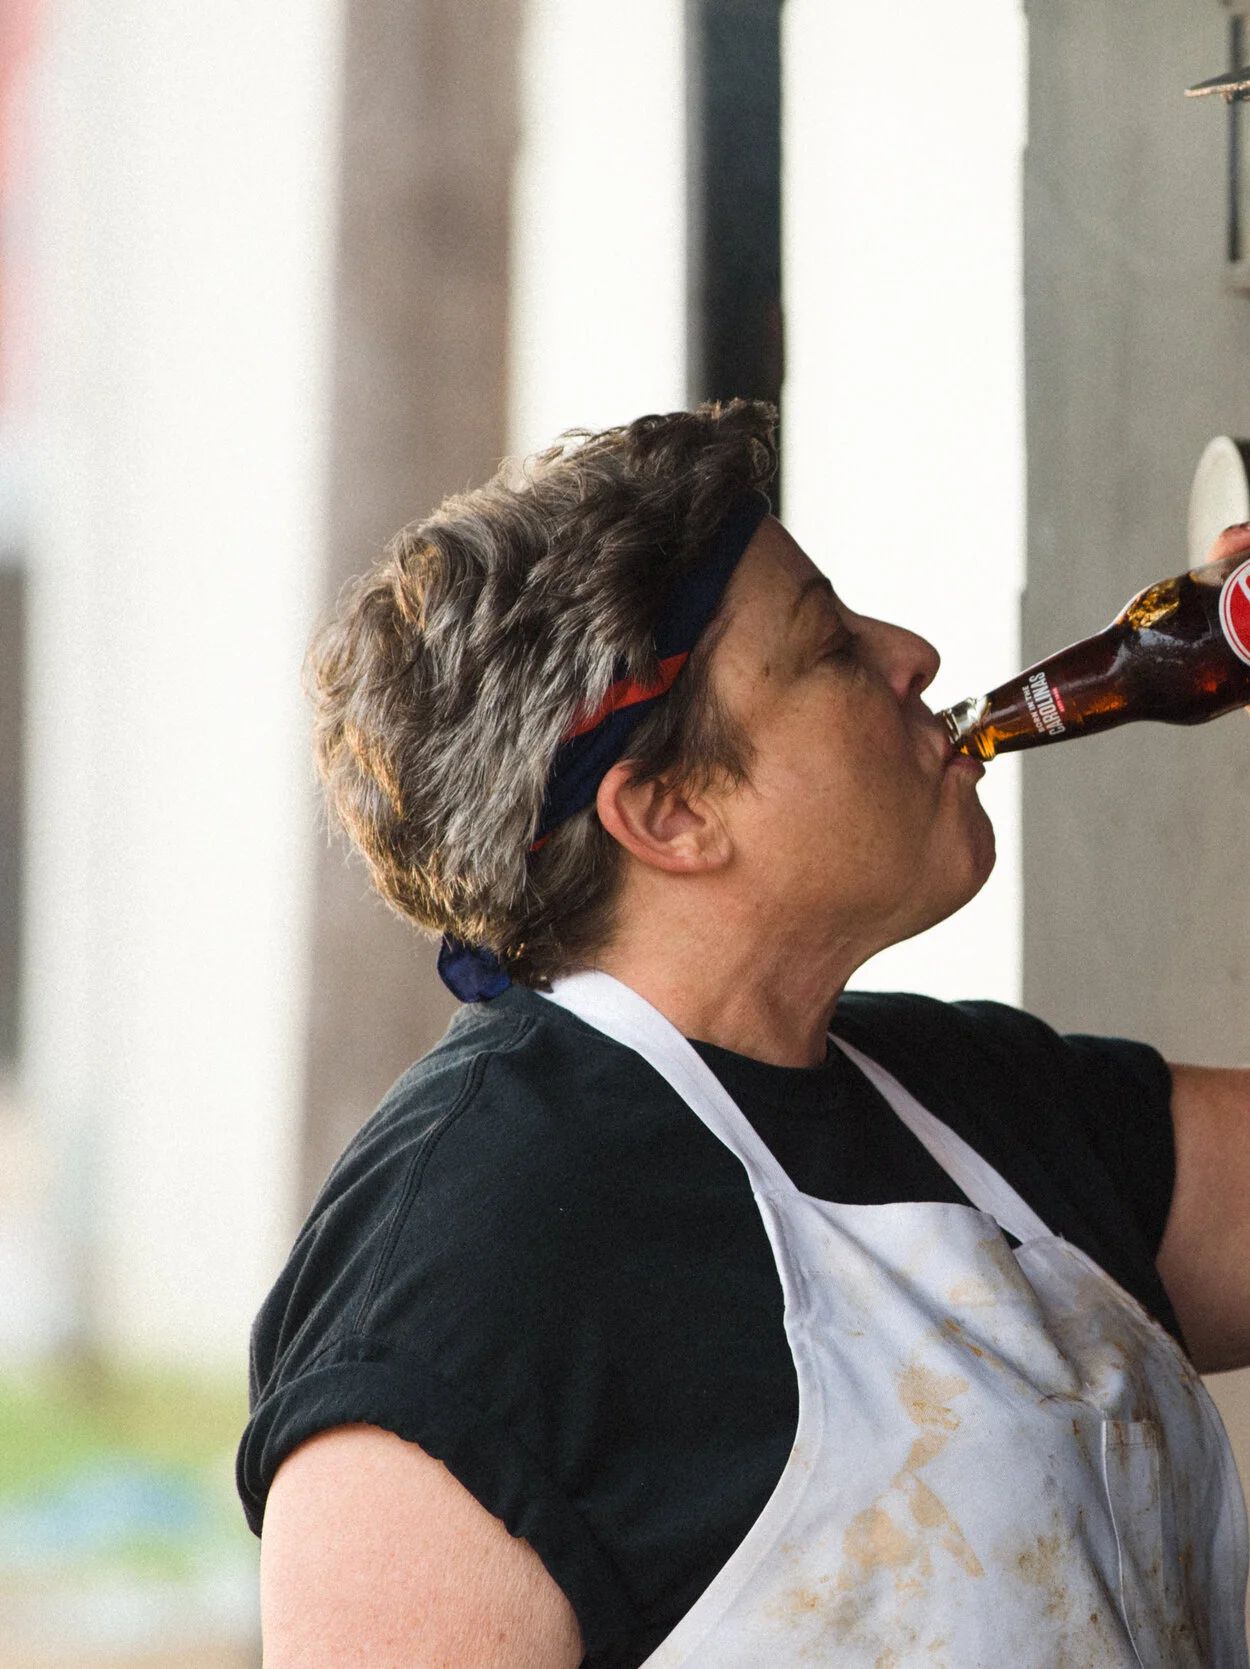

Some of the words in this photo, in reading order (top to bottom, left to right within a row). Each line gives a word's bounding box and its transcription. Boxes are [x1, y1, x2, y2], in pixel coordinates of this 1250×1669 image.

[1022, 685, 1032, 702] THE
[1027, 701, 1036, 711] IN
[1028, 672, 1065, 735] CAROLINAS
[1030, 711, 1045, 733] BORN
